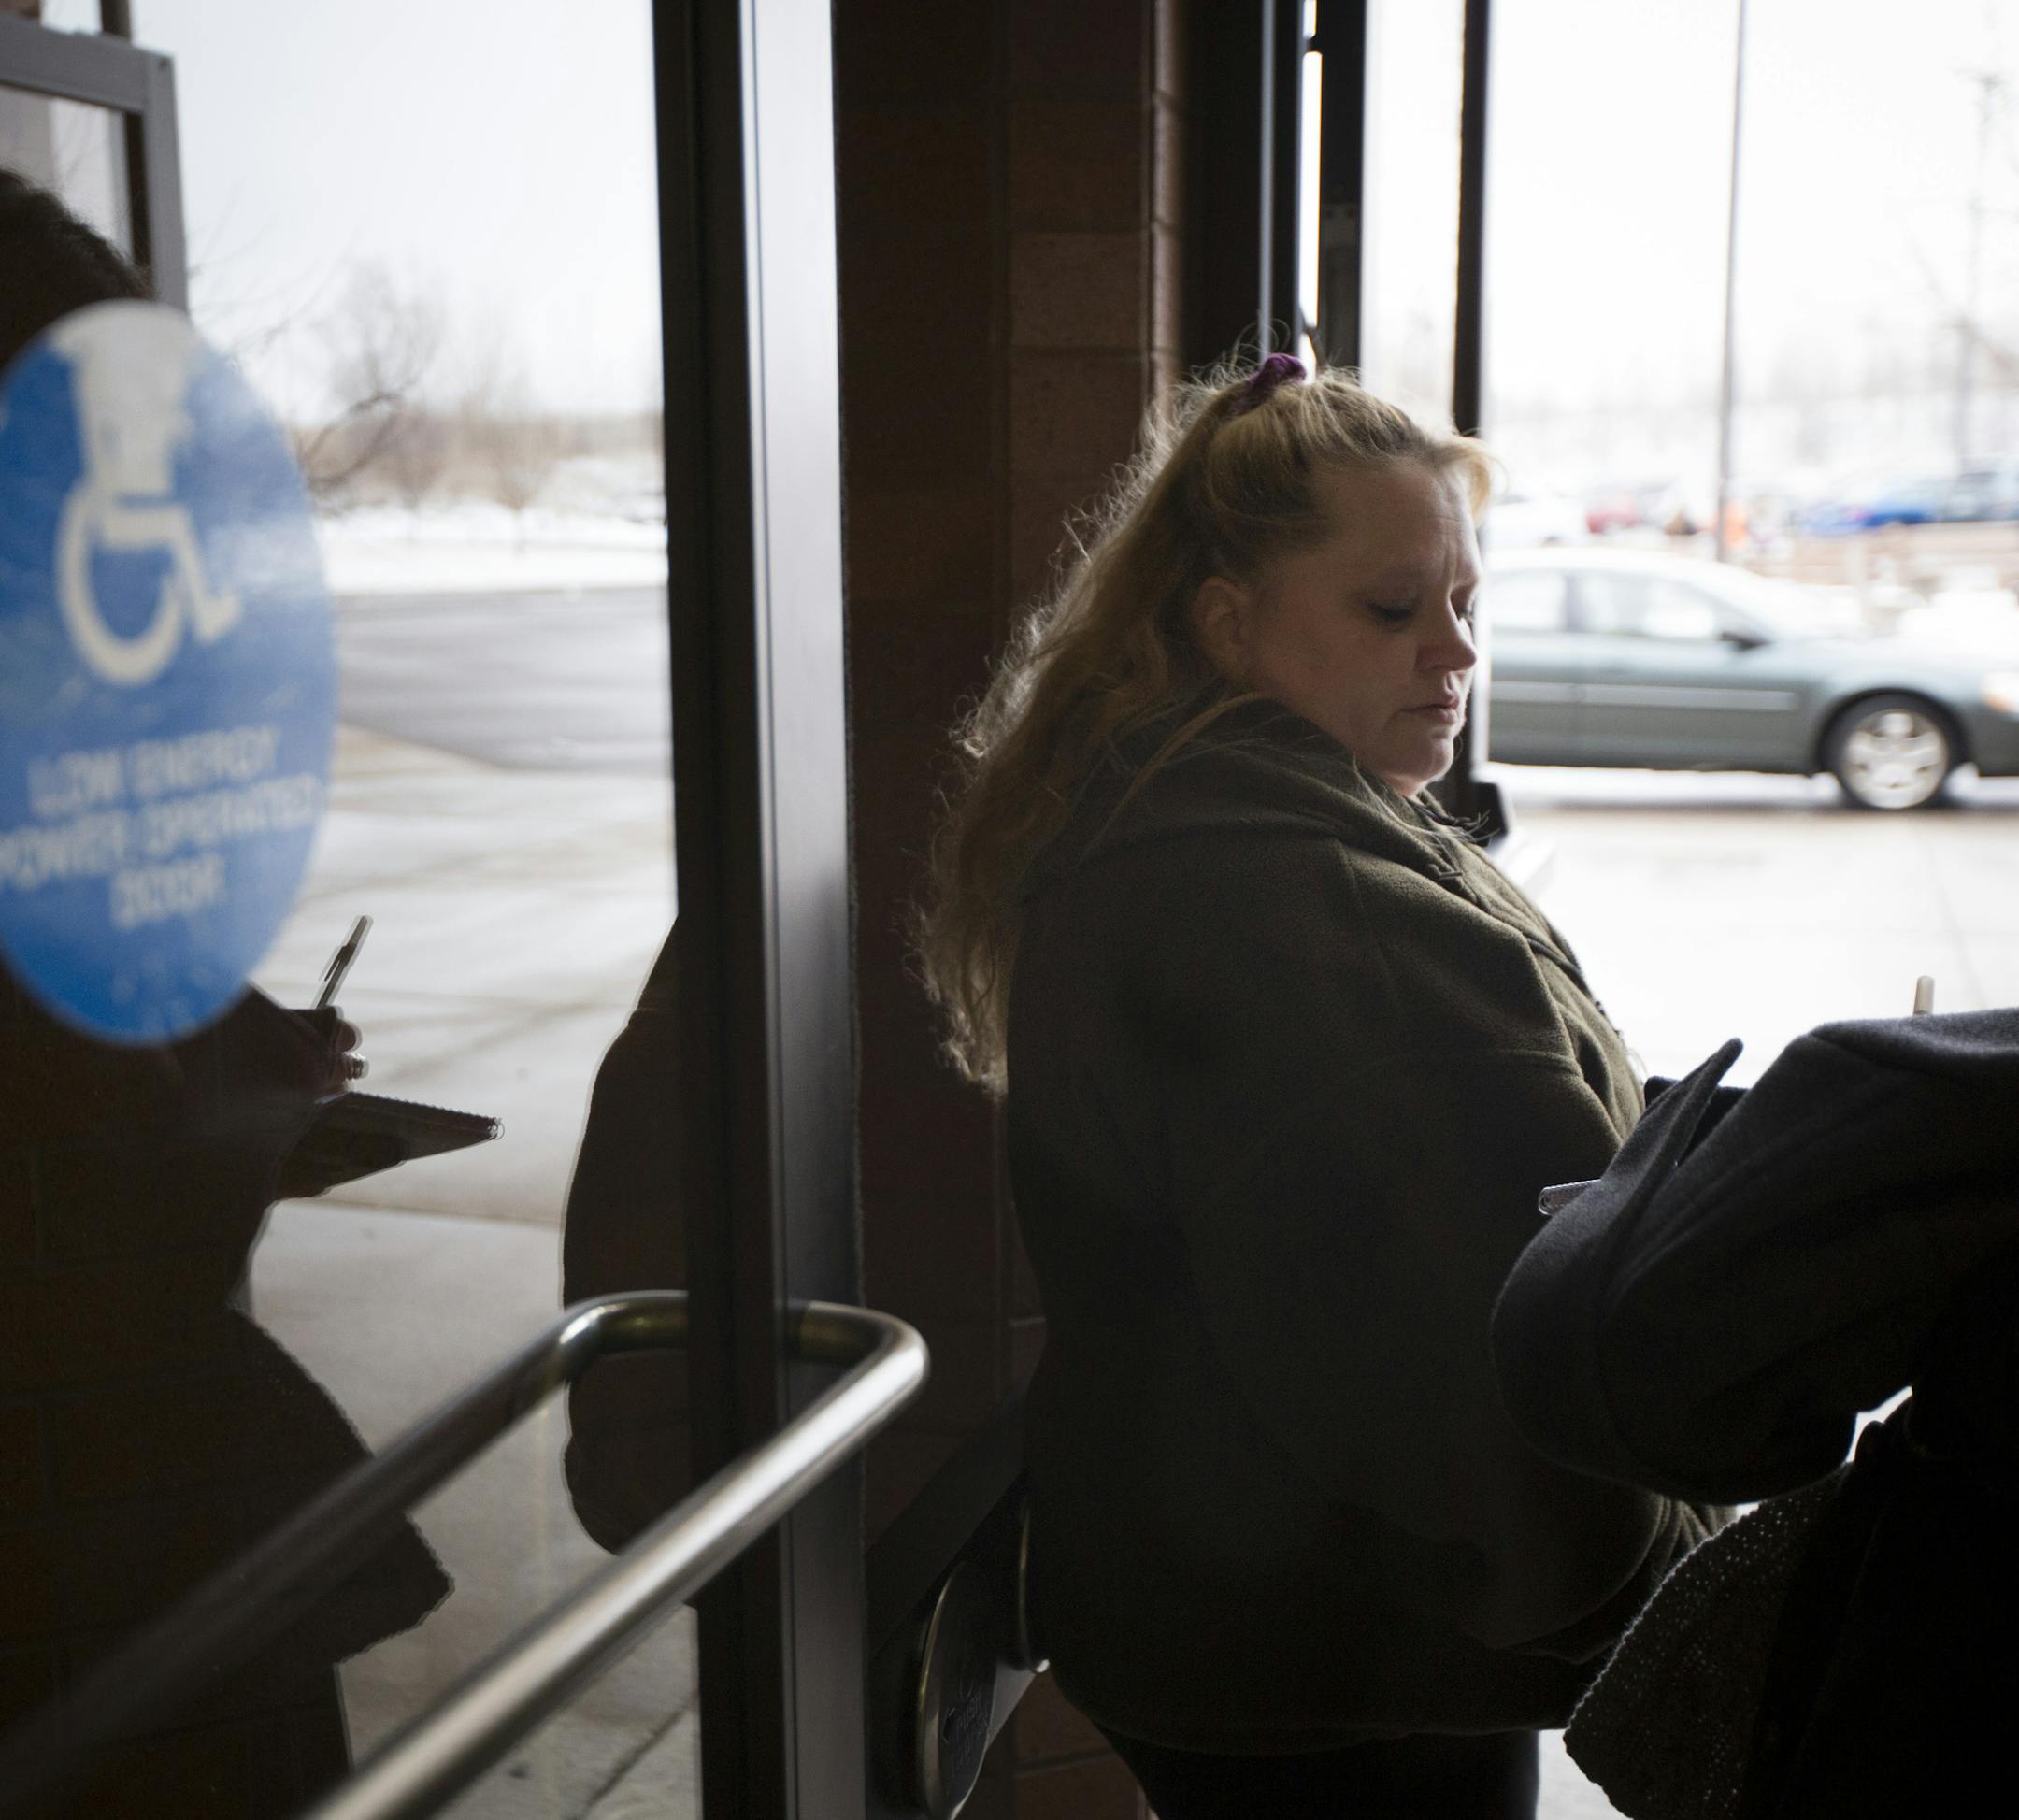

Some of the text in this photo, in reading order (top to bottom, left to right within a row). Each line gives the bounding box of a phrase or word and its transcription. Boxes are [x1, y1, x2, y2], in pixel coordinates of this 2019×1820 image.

[27, 724, 278, 814] LOW ENERGY
[138, 774, 320, 854] OPERATED
[110, 853, 224, 929] DOOR
